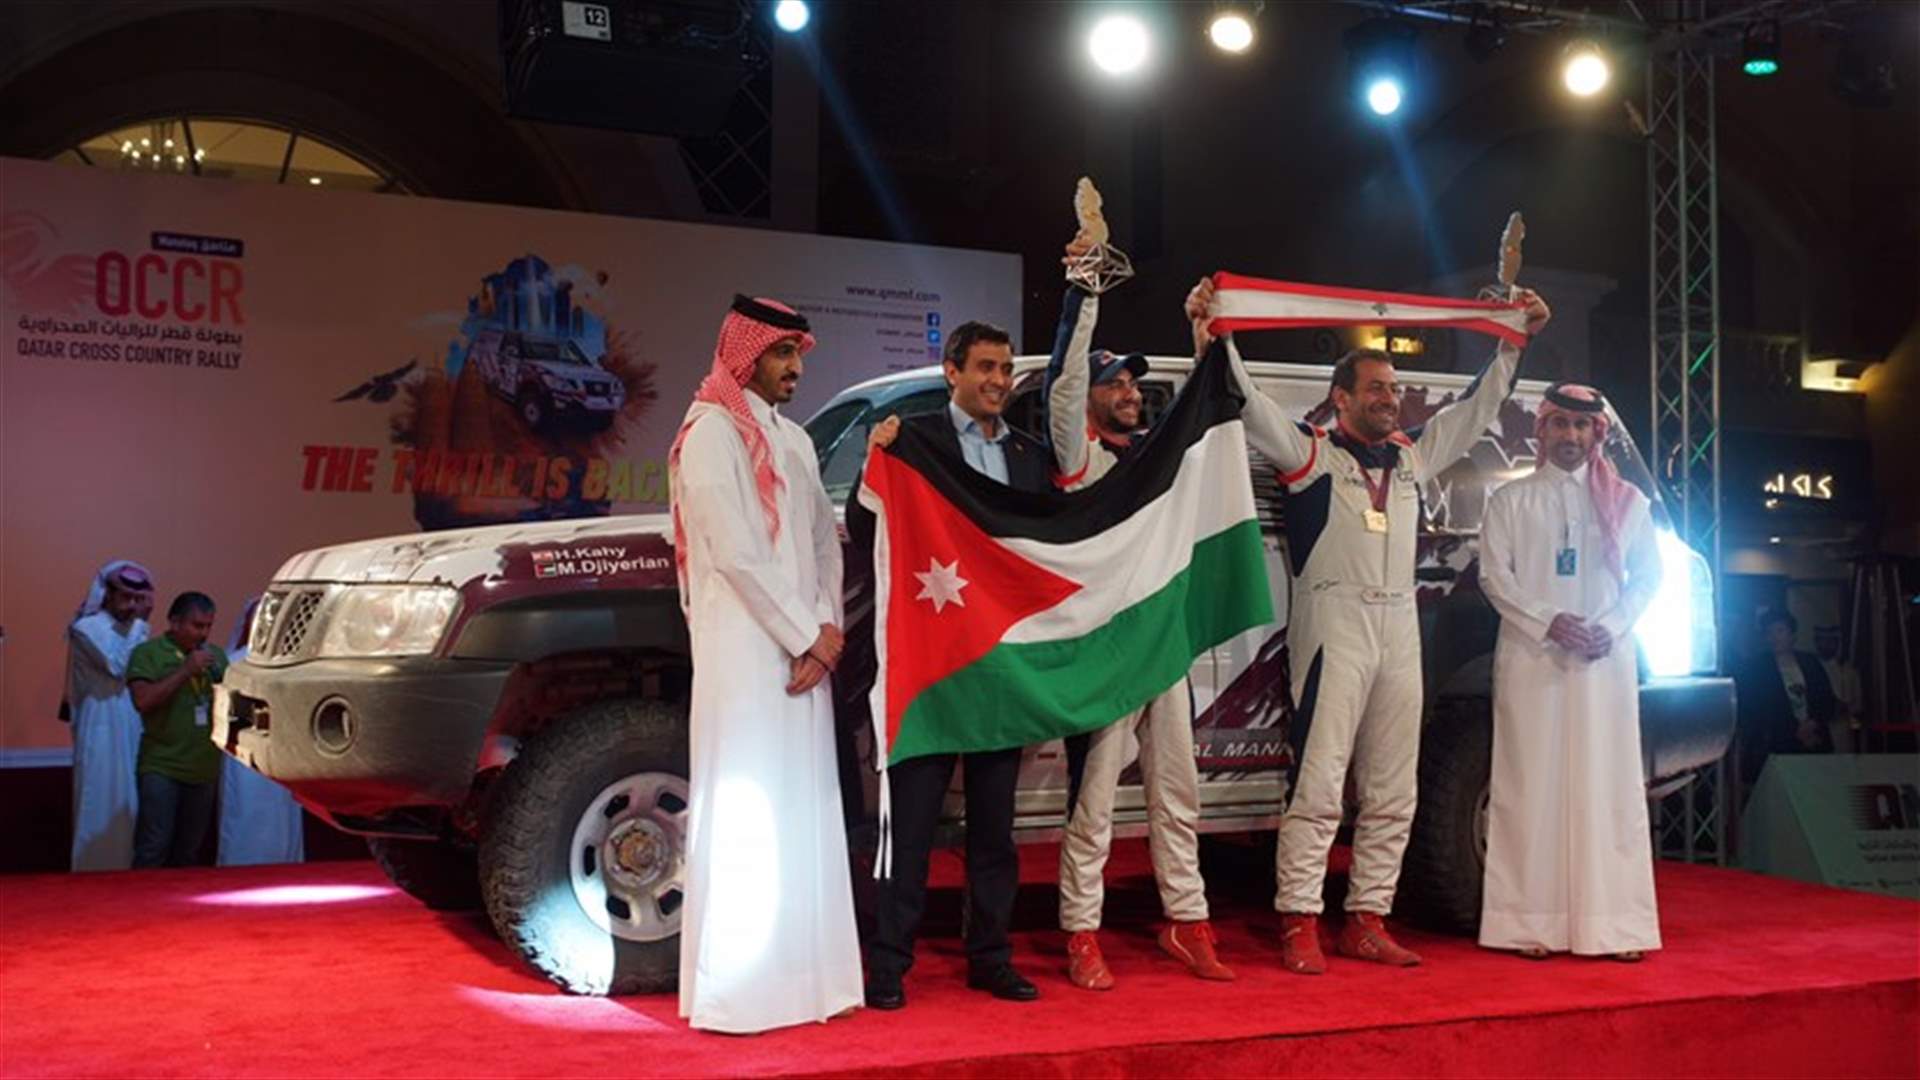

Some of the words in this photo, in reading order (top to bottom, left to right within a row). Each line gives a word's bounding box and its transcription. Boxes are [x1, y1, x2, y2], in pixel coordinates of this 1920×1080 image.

[588, 9, 605, 25] 12
[96, 251, 244, 325] QCCR
[17, 338, 67, 358] QATAR
[69, 341, 120, 362] CROSS
[125, 345, 192, 366] COUNTRY
[197, 350, 241, 369] RALLY
[303, 446, 378, 492] THE
[391, 450, 522, 498] THRILL
[530, 456, 572, 499] IS
[555, 546, 626, 562] H.Kahy
